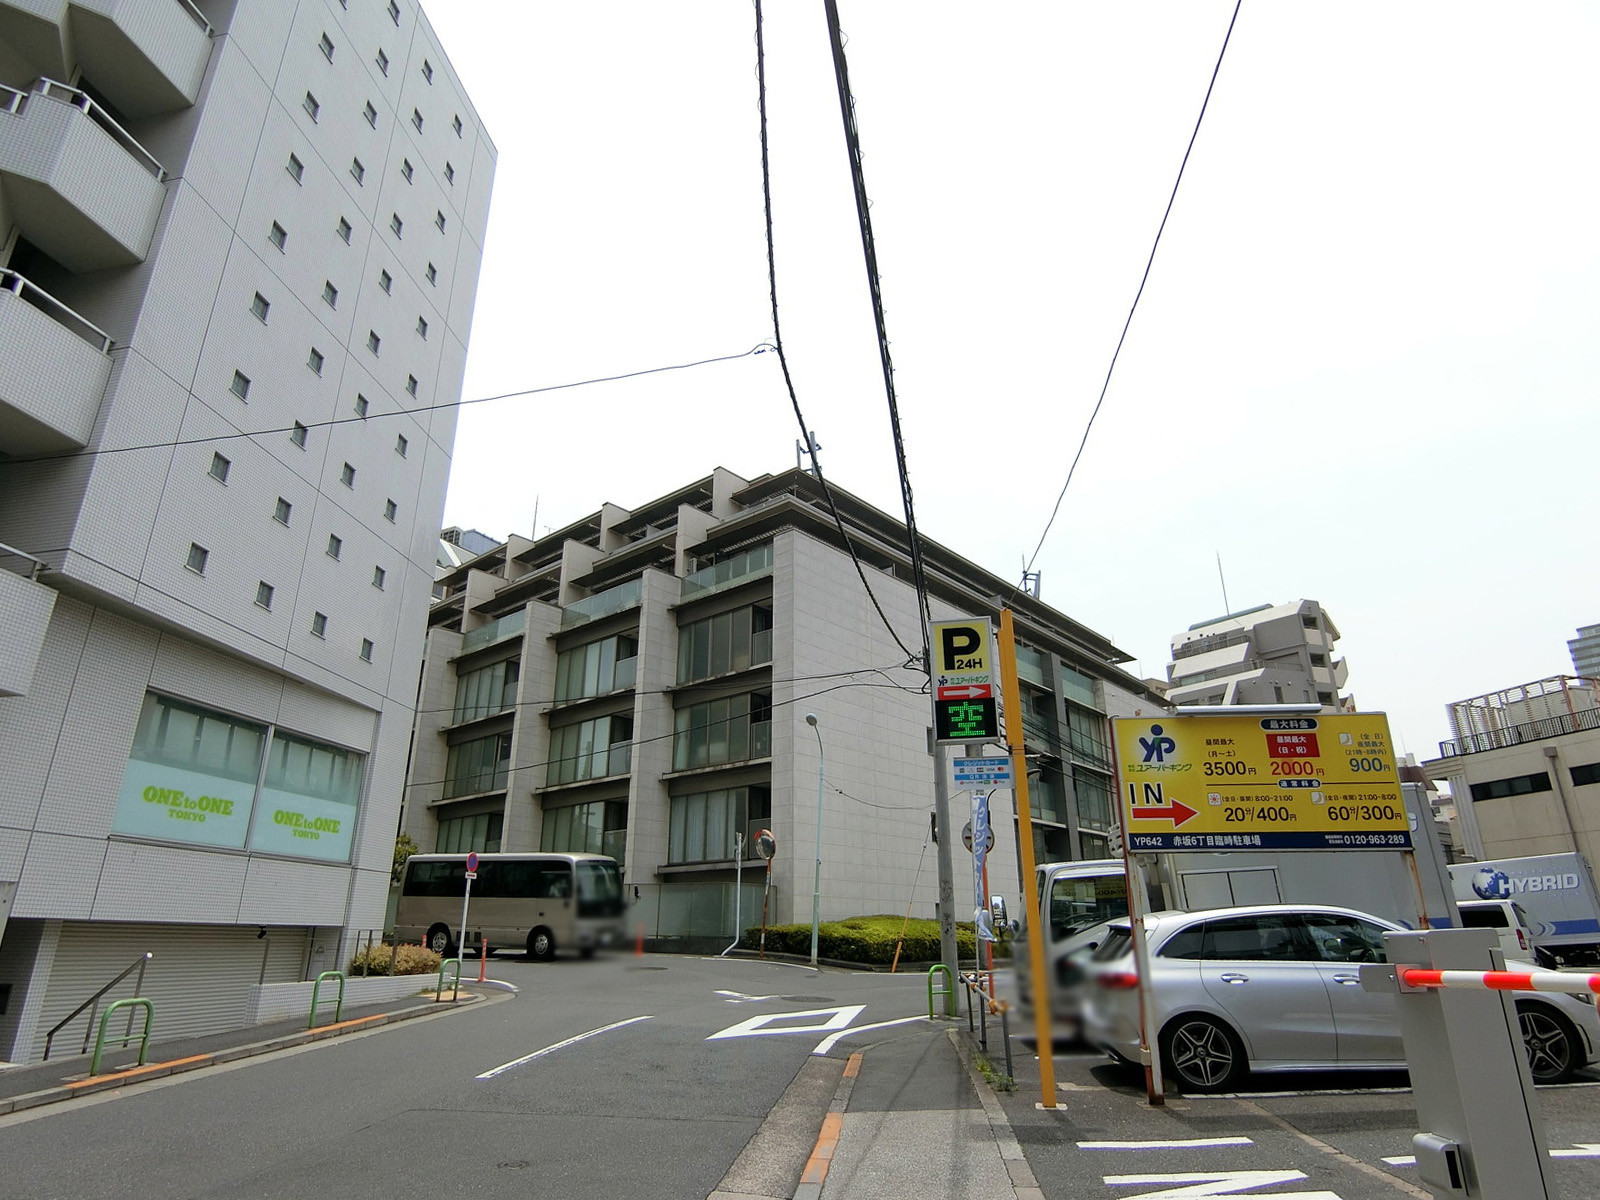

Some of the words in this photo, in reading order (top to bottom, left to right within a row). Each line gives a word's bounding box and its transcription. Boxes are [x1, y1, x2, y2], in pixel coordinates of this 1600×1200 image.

[942, 627, 981, 671] P
[956, 658, 983, 670] 24H
[948, 701, 986, 737] 空
[1269, 719, 1309, 730] 最大料金
[1202, 760, 1257, 777] 3500円
[1269, 760, 1325, 777] 2000円
[1348, 757, 1391, 773] 900円
[142, 785, 184, 808] ONE
[184, 796, 197, 810] to
[197, 795, 235, 816] ONE
[1128, 782, 1165, 805] IN
[168, 807, 206, 823] TOKYO
[272, 809, 304, 828] ONE
[303, 818, 314, 830] to
[313, 816, 341, 834] ONE
[291, 829, 320, 840] TOKYO
[1133, 837, 1163, 846] YP642
[1344, 834, 1405, 845] 0120-963-289
[1498, 873, 1580, 895] HYBRID
